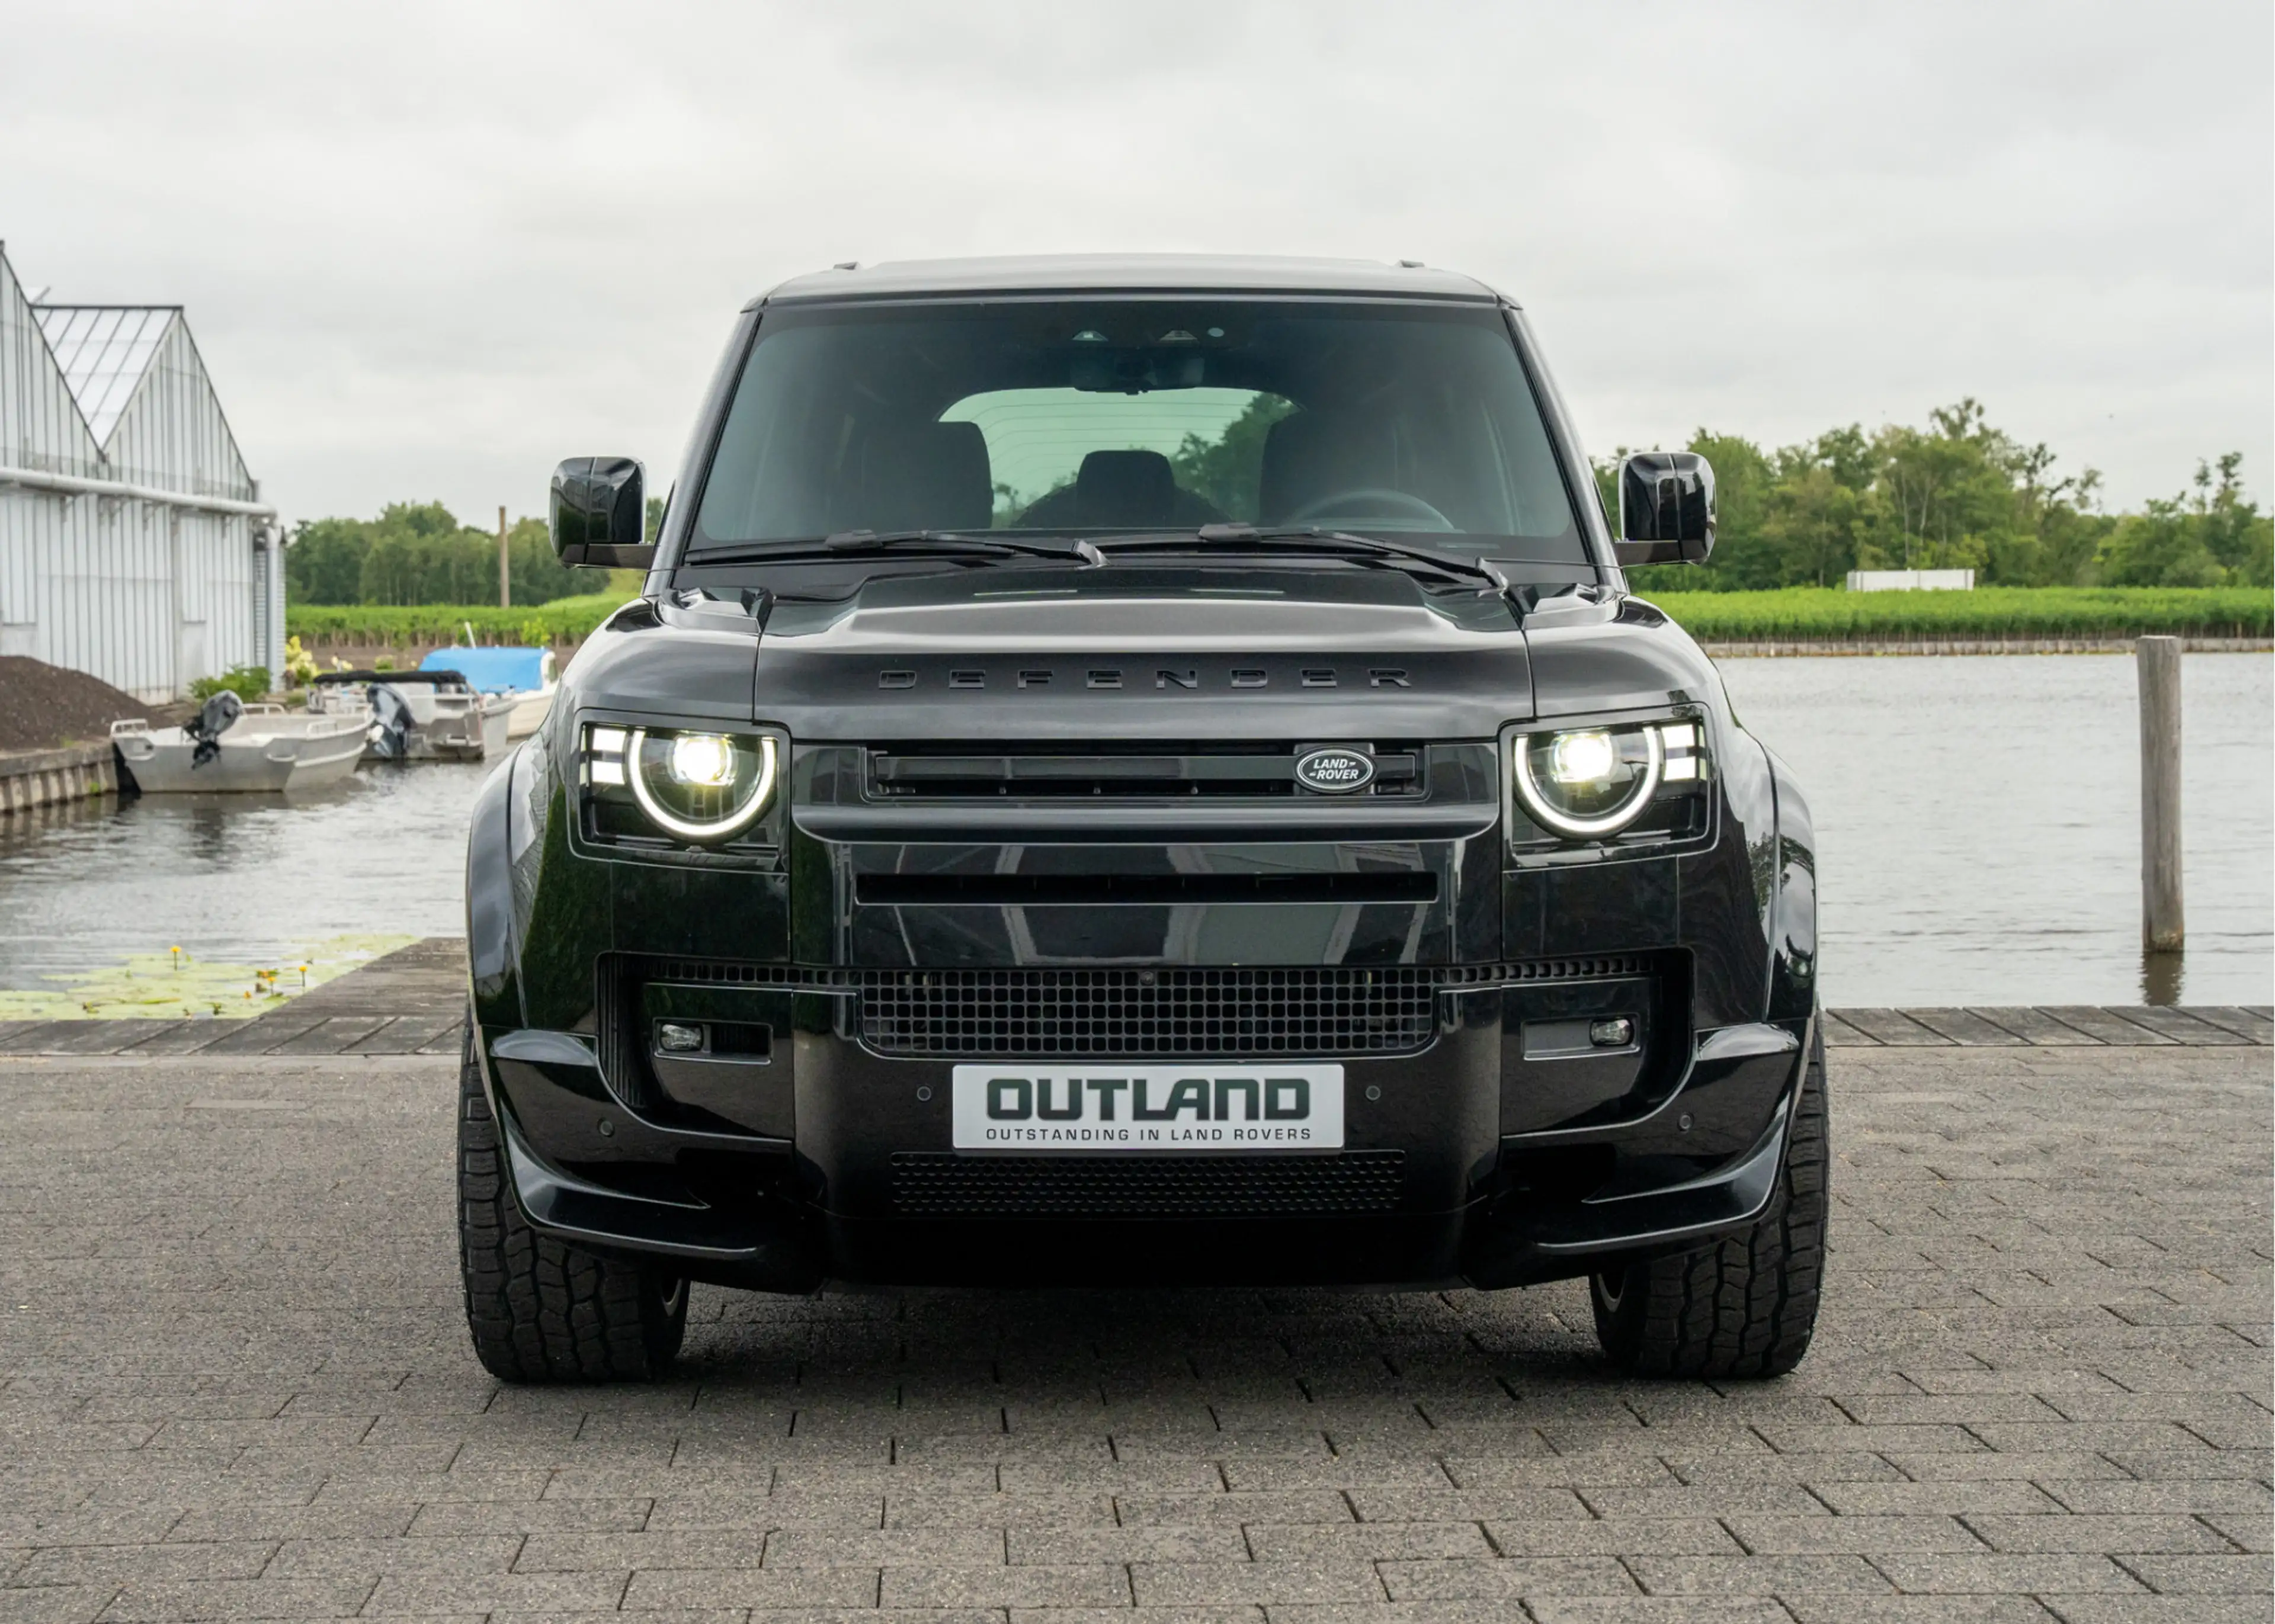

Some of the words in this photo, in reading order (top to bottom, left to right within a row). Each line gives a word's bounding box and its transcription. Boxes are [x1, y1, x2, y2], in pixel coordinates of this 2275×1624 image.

[879, 667, 1411, 689] DEFENDER
[986, 1078, 1310, 1121] OUTLAND
[986, 1128, 1129, 1141] OUTSTANDING
[1140, 1128, 1159, 1141] IN
[1171, 1128, 1223, 1141] LAND
[1233, 1128, 1311, 1141] ROVERS
